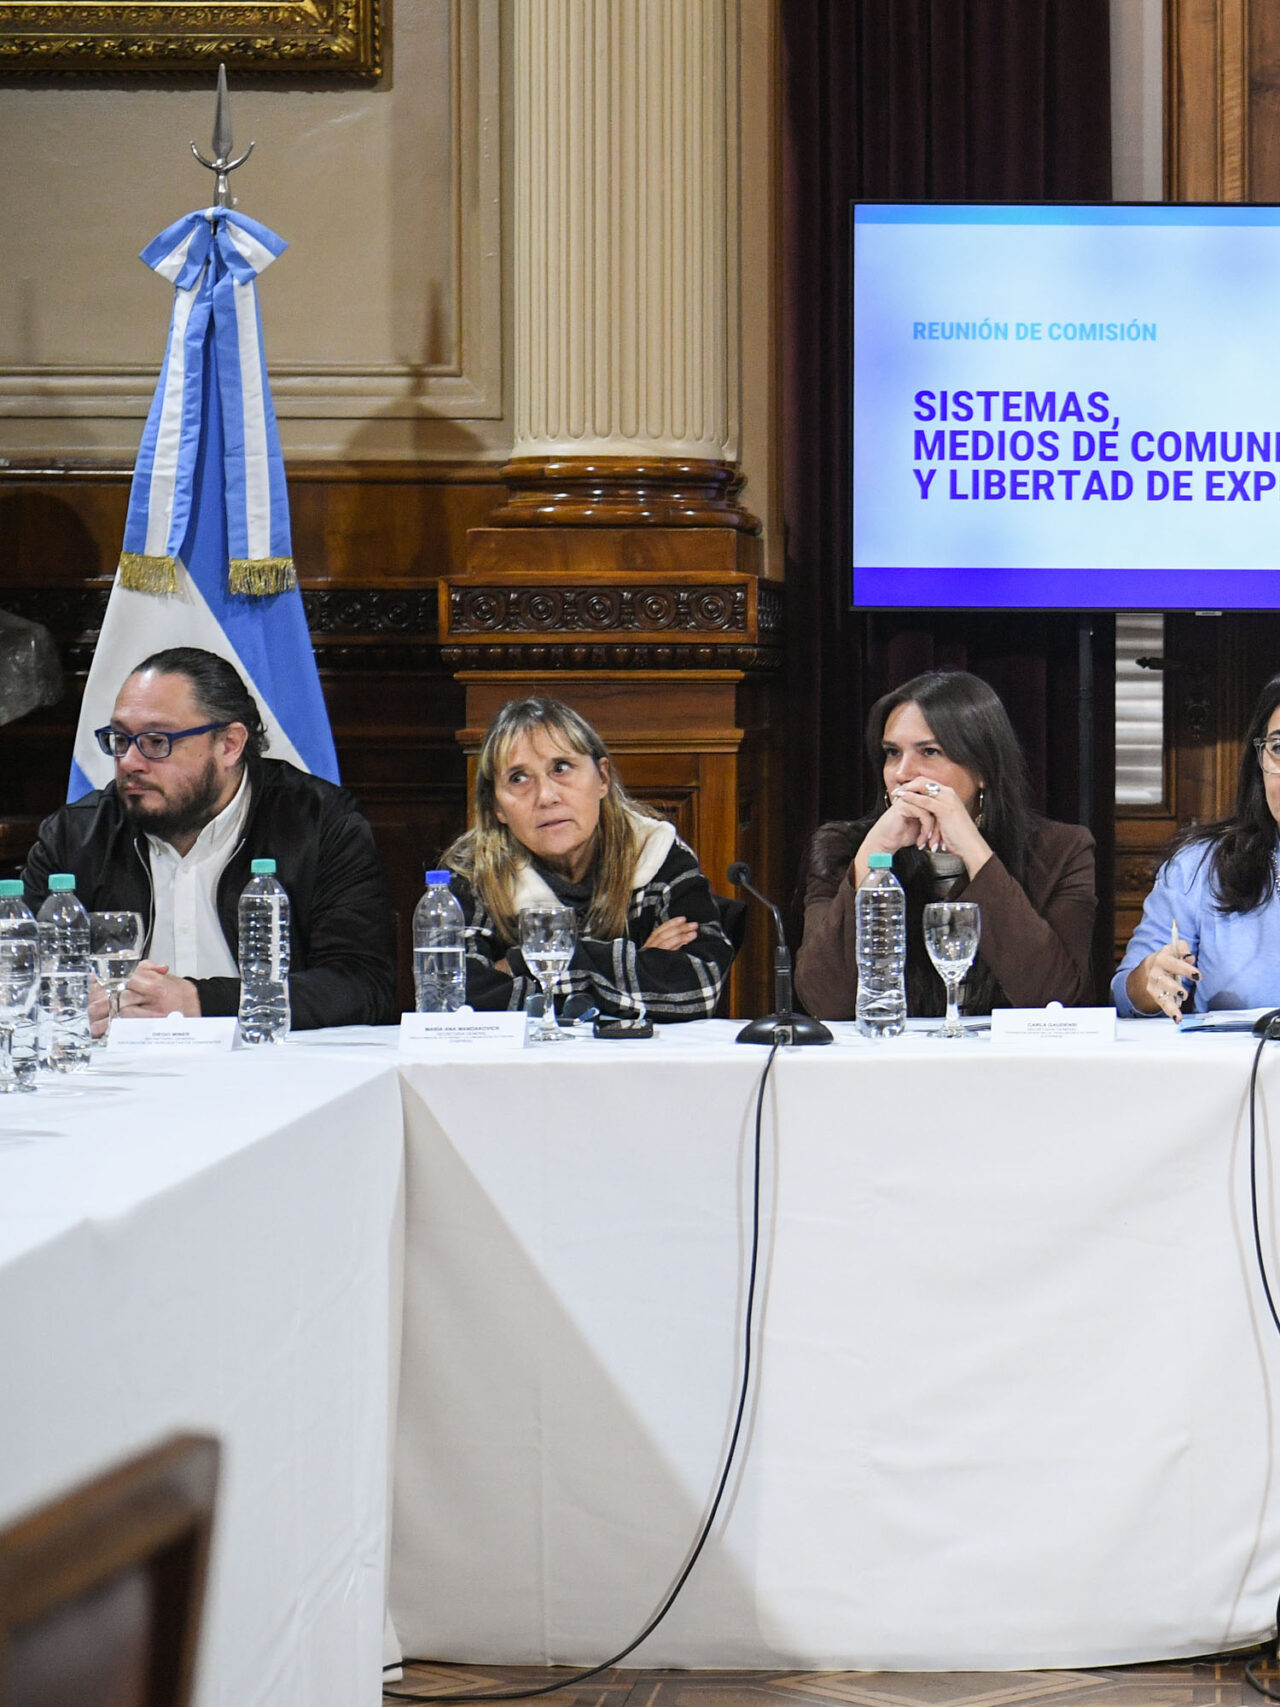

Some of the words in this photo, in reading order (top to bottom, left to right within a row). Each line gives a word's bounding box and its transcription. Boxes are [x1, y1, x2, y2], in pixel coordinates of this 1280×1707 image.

[912, 317, 1009, 341] REUNIÓN
[1015, 322, 1042, 341] DE
[1048, 318, 1157, 342] COMISIÓN
[913, 389, 1120, 428] SISTEMAS,
[913, 429, 1060, 462] MEDIOS
[1072, 430, 1119, 462] DE
[912, 468, 937, 500] Y
[949, 469, 1134, 501] LIBERTAD
[1146, 470, 1194, 502] DE
